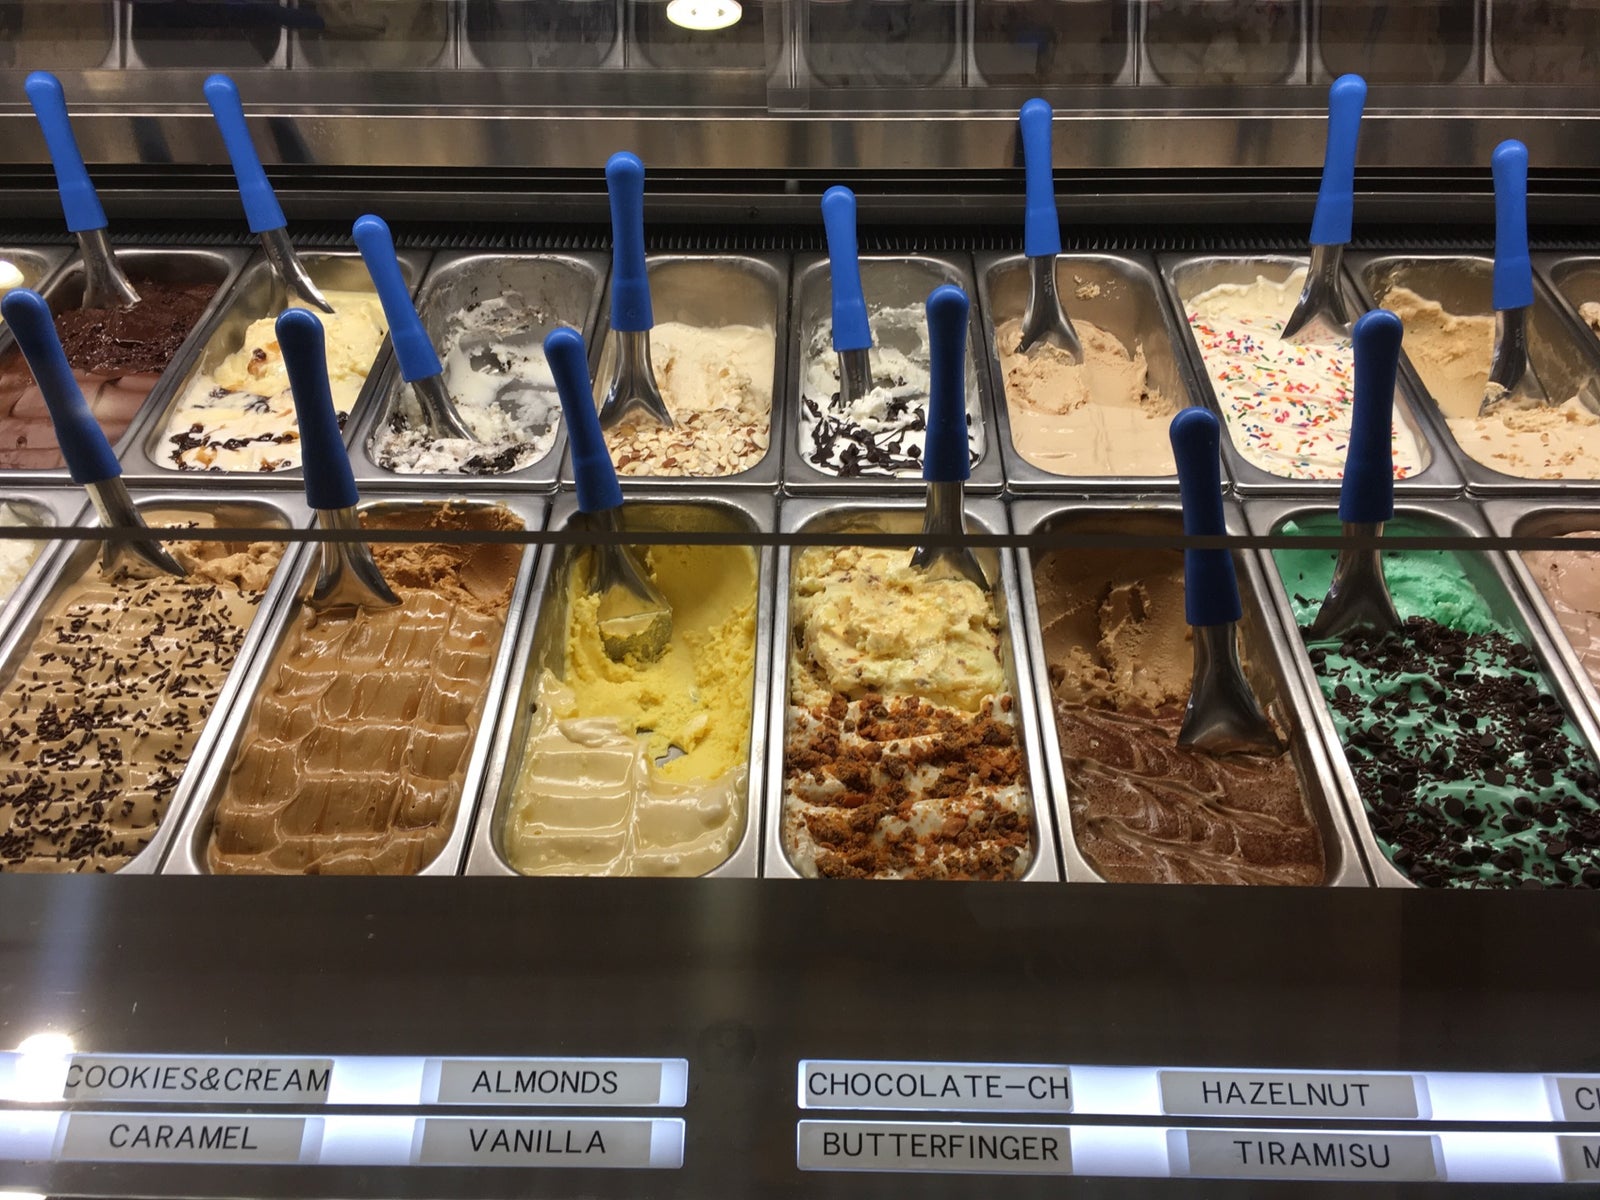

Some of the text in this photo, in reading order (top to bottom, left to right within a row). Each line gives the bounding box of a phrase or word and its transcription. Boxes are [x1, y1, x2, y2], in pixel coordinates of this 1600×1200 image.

[66, 1064, 330, 1092] COOKIES&CREAM
[471, 1070, 618, 1094] ALMONDS
[1202, 1081, 1370, 1107] HAZELNUT
[109, 1124, 258, 1150] CARAMEL
[469, 1128, 606, 1153] VANILLA
[823, 1132, 1059, 1160] BUTTERFINGER
[1233, 1140, 1390, 1168] TIRAMISU
